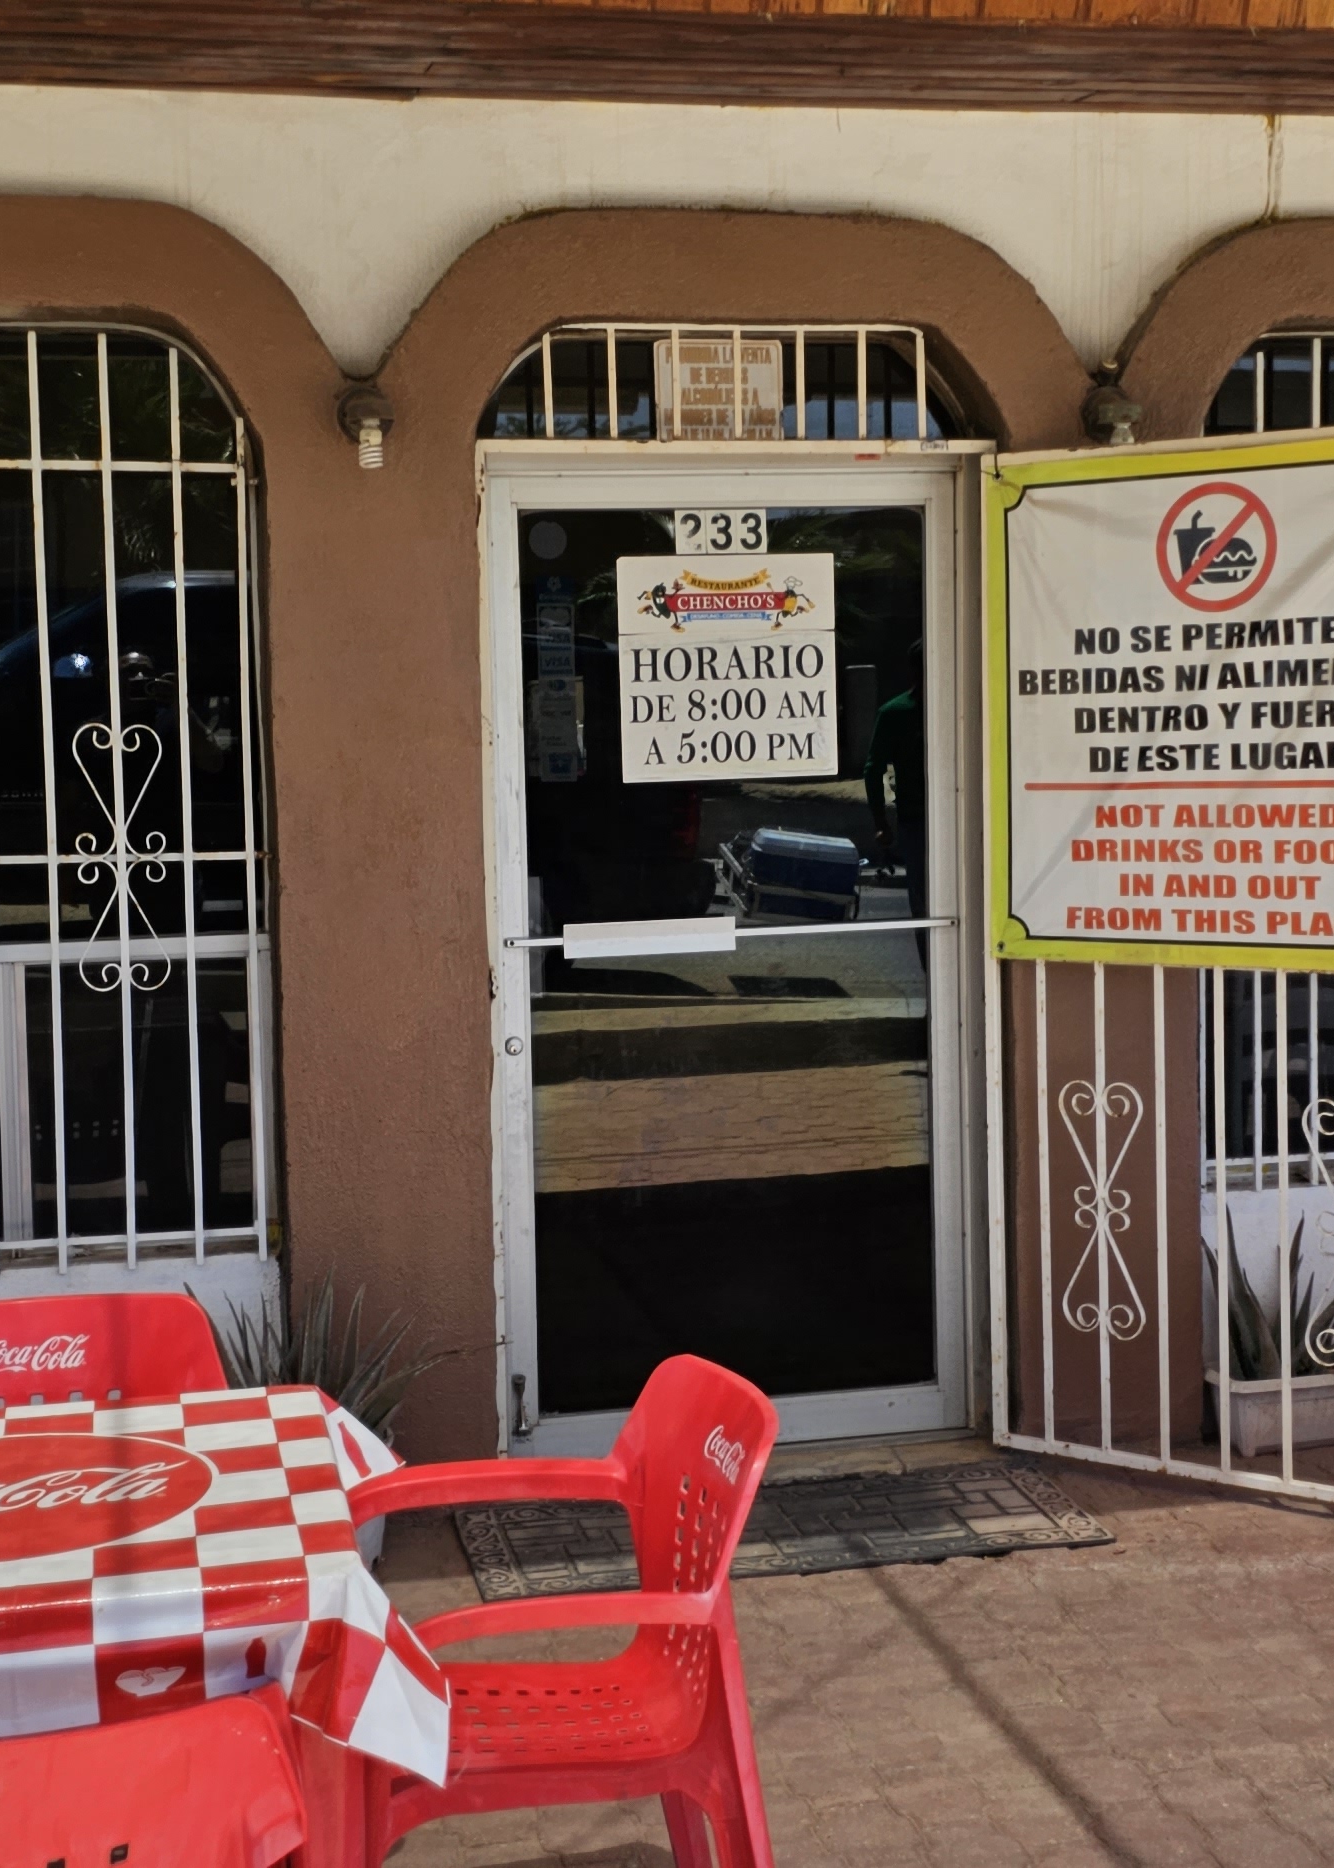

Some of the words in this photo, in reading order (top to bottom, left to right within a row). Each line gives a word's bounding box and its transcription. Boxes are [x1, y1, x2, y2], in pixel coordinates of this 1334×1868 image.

[691, 577, 760, 591] RESTAURANTE
[1074, 628, 1120, 655] NO
[1130, 624, 1171, 653] SE
[630, 644, 824, 683] HORARIO
[1018, 666, 1165, 696] BEBIDAS
[1175, 663, 1209, 692] NI
[629, 695, 676, 723] DE
[687, 688, 766, 721] 8:00
[776, 690, 827, 719] AM
[1074, 703, 1208, 734] DENTRO
[1218, 702, 1242, 730] Y
[644, 736, 666, 765] A
[677, 729, 757, 764] 5:00
[766, 732, 815, 761] PM
[1089, 746, 1129, 773] DE
[1137, 744, 1220, 772] ESTE
[1095, 804, 1165, 828] NOT
[1071, 839, 1204, 863] DRINKS
[1213, 839, 1263, 864] OR
[1119, 873, 1154, 897] IN
[1163, 874, 1237, 898] AND
[1247, 875, 1321, 900] OUT
[1066, 906, 1162, 932] FROM
[1171, 909, 1256, 934] THIS
